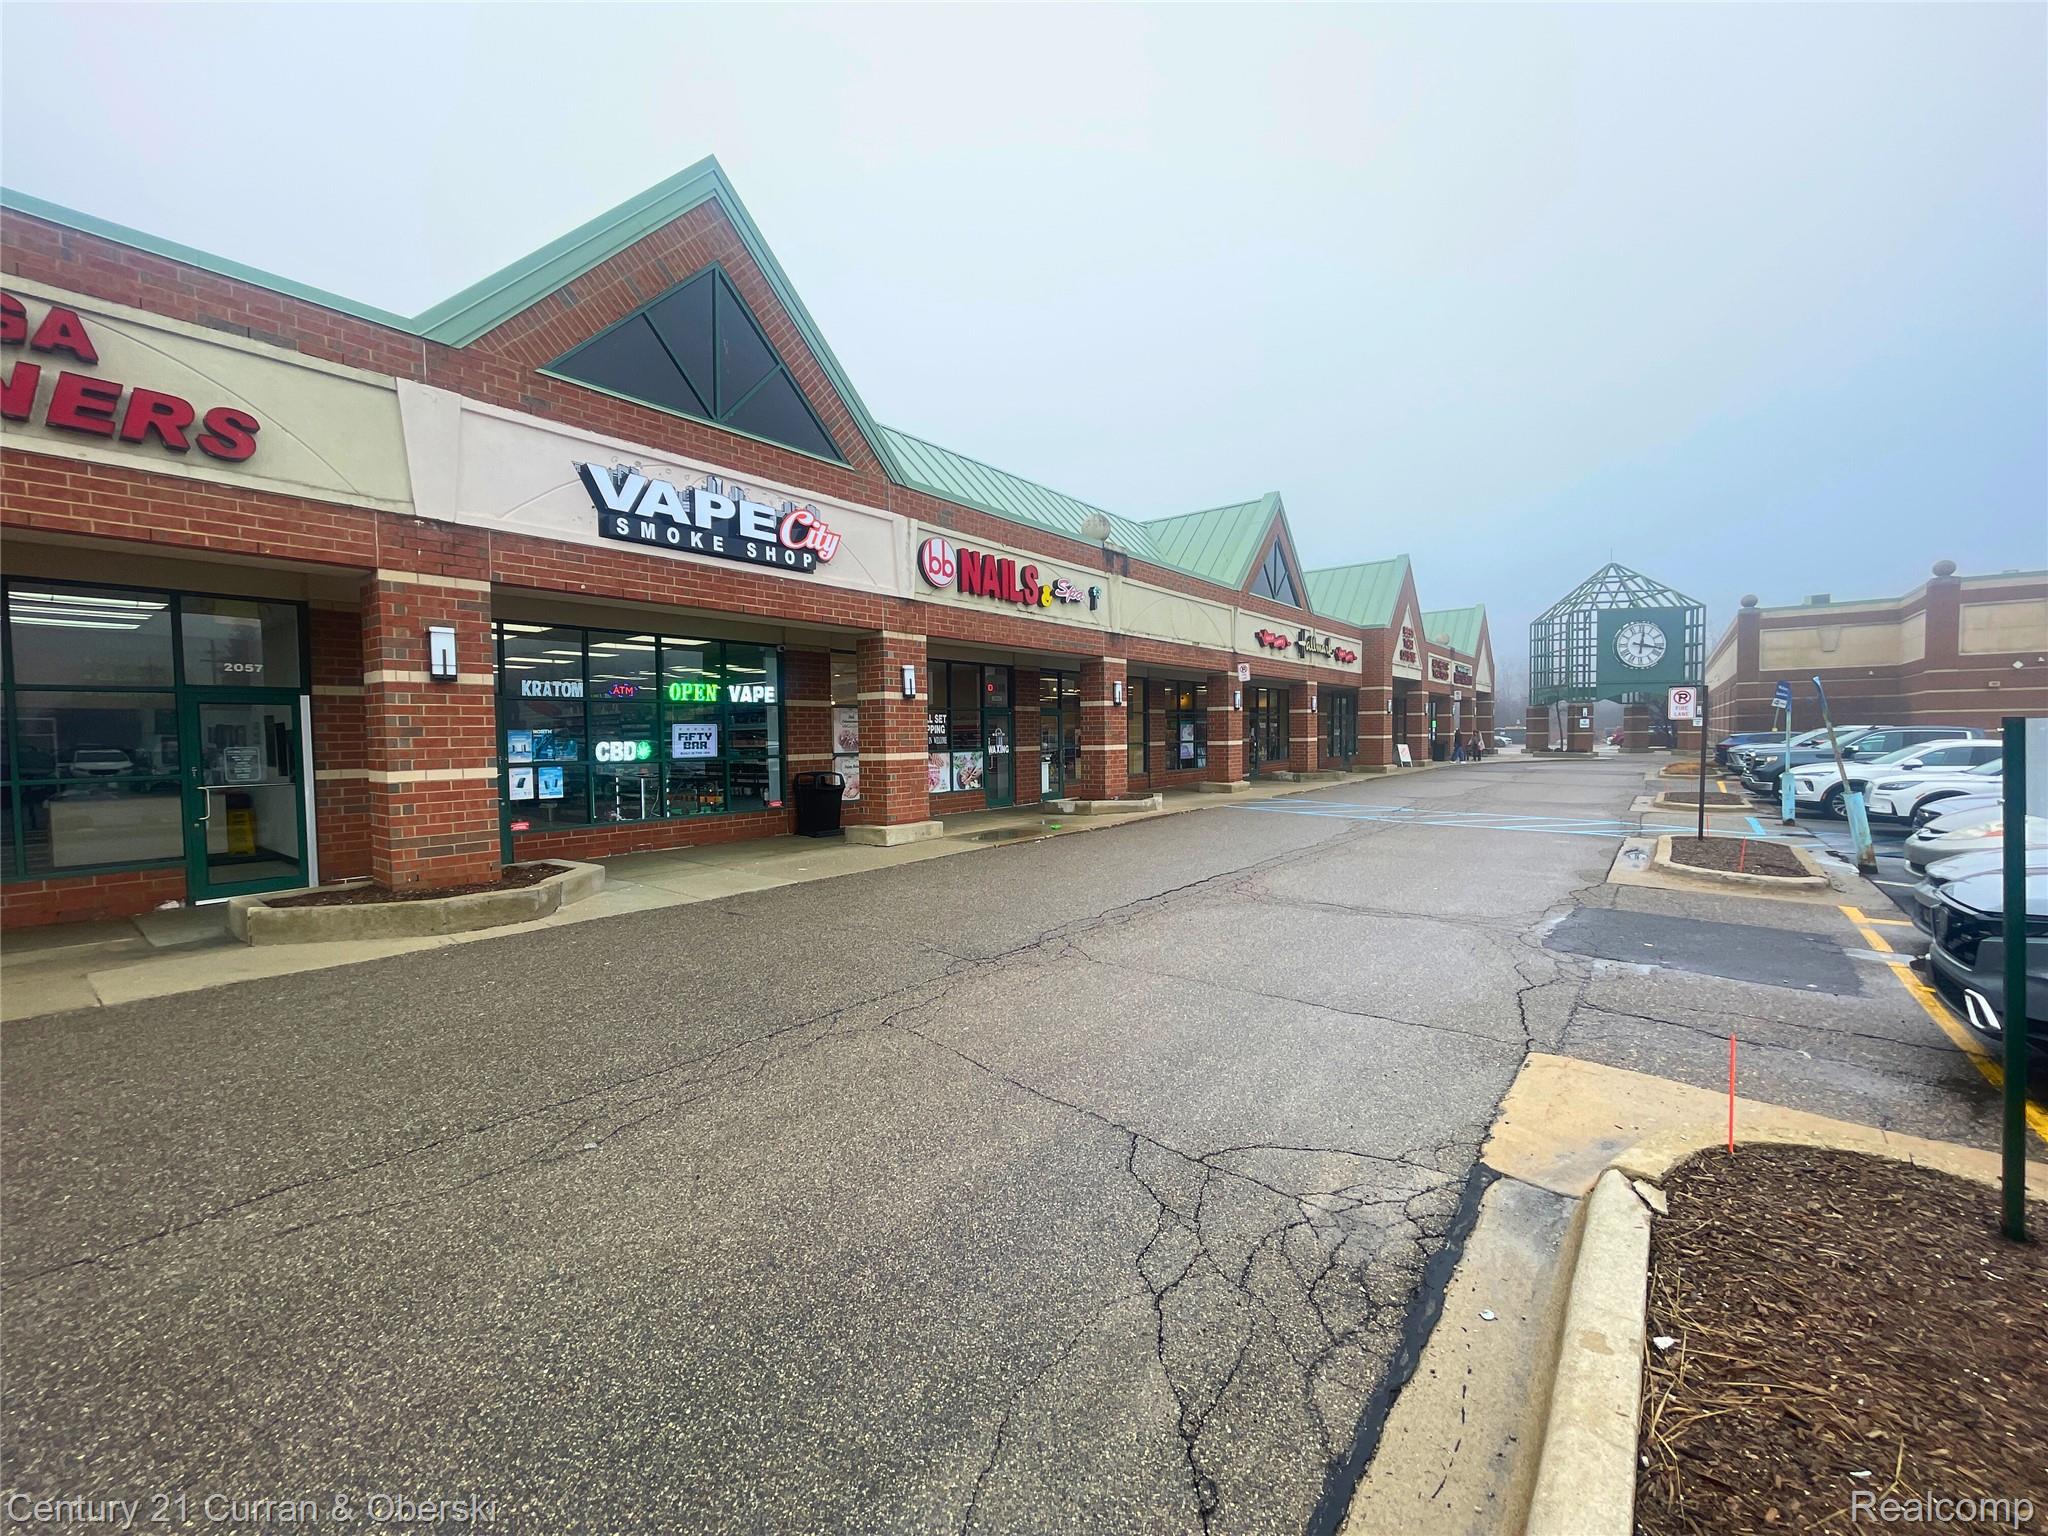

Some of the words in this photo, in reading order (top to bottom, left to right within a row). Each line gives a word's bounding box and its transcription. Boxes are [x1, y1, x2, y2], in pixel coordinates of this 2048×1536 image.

[584, 463, 777, 543] VAPE
[780, 508, 842, 563] City
[616, 517, 724, 552] SMOKE
[746, 542, 813, 568] SHOP
[958, 547, 1039, 606] NAILS
[1039, 585, 1053, 608] &
[1054, 578, 1085, 603] Spa
[223, 663, 264, 672] 2057
[521, 679, 584, 698] KRATOM
[613, 685, 635, 697] ATM
[668, 682, 719, 702] OPEN
[728, 684, 777, 703] VAPE
[934, 713, 948, 724] SET
[595, 741, 637, 762] CBD
[683, 741, 708, 750] BAR
[987, 744, 1010, 754] WAXING
